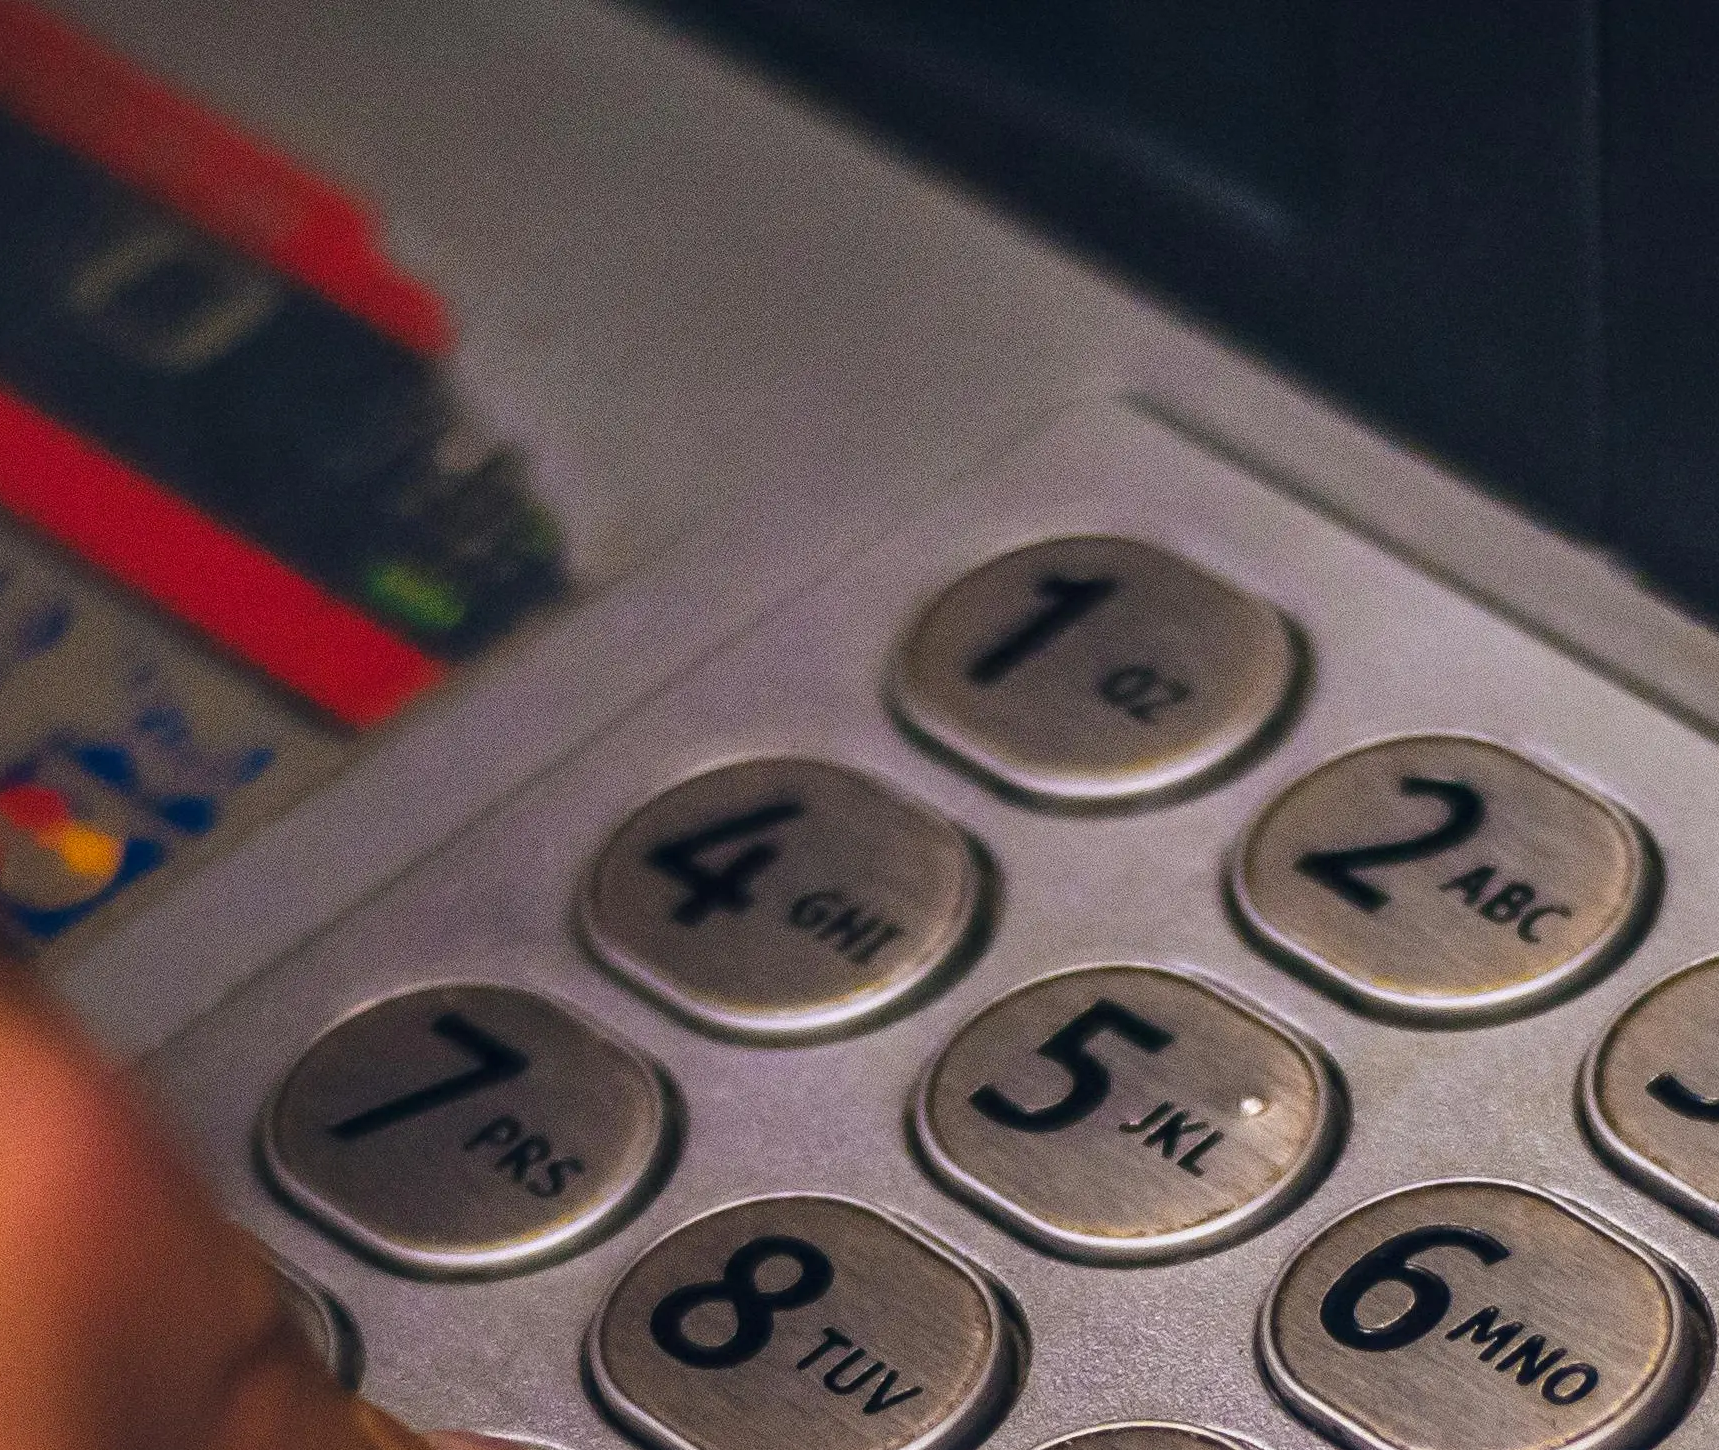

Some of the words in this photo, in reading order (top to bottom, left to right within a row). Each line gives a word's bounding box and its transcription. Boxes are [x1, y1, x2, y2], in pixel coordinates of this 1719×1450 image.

[967, 573, 1121, 688] 1
[646, 795, 805, 928] 4
[786, 889, 908, 967] GHI
[1292, 775, 1484, 912] 2
[1439, 864, 1575, 946] ABC
[327, 1010, 531, 1142] 7
[461, 1112, 587, 1202] PRS
[968, 998, 1175, 1134] 5
[1117, 1100, 1226, 1179] JKL
[648, 1235, 836, 1371] 8
[794, 1325, 924, 1417] TUV
[1319, 1223, 1513, 1353] 6
[1445, 1304, 1600, 1407] MNO
